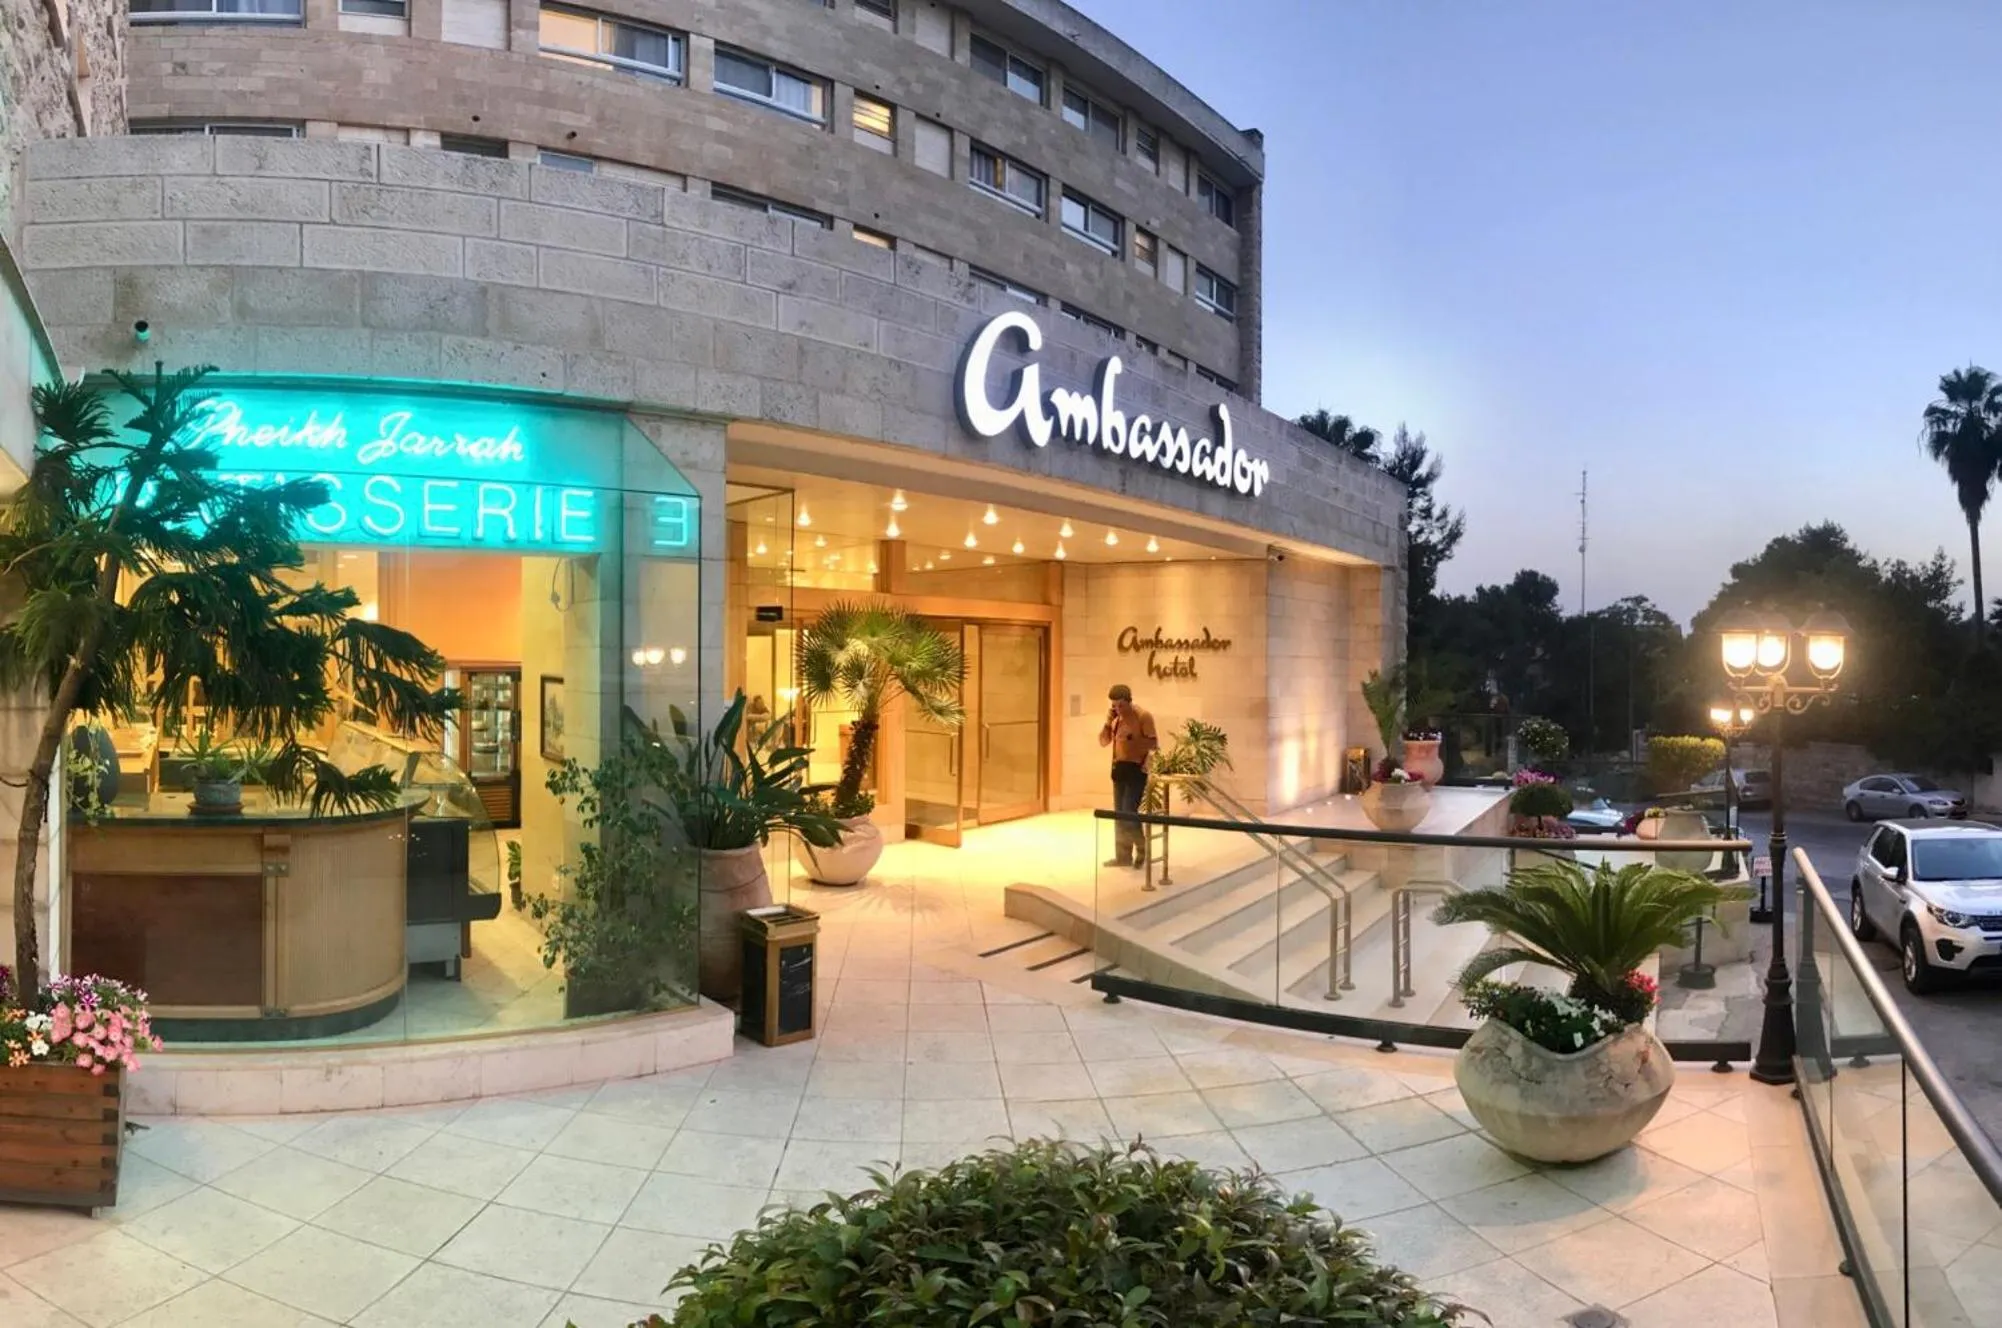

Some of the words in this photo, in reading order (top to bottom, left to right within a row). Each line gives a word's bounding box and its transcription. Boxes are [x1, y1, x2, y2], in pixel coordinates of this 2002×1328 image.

[964, 310, 1270, 497] Ambassador
[356, 410, 526, 466] Jarrah
[1117, 626, 1232, 653] Ambassador
